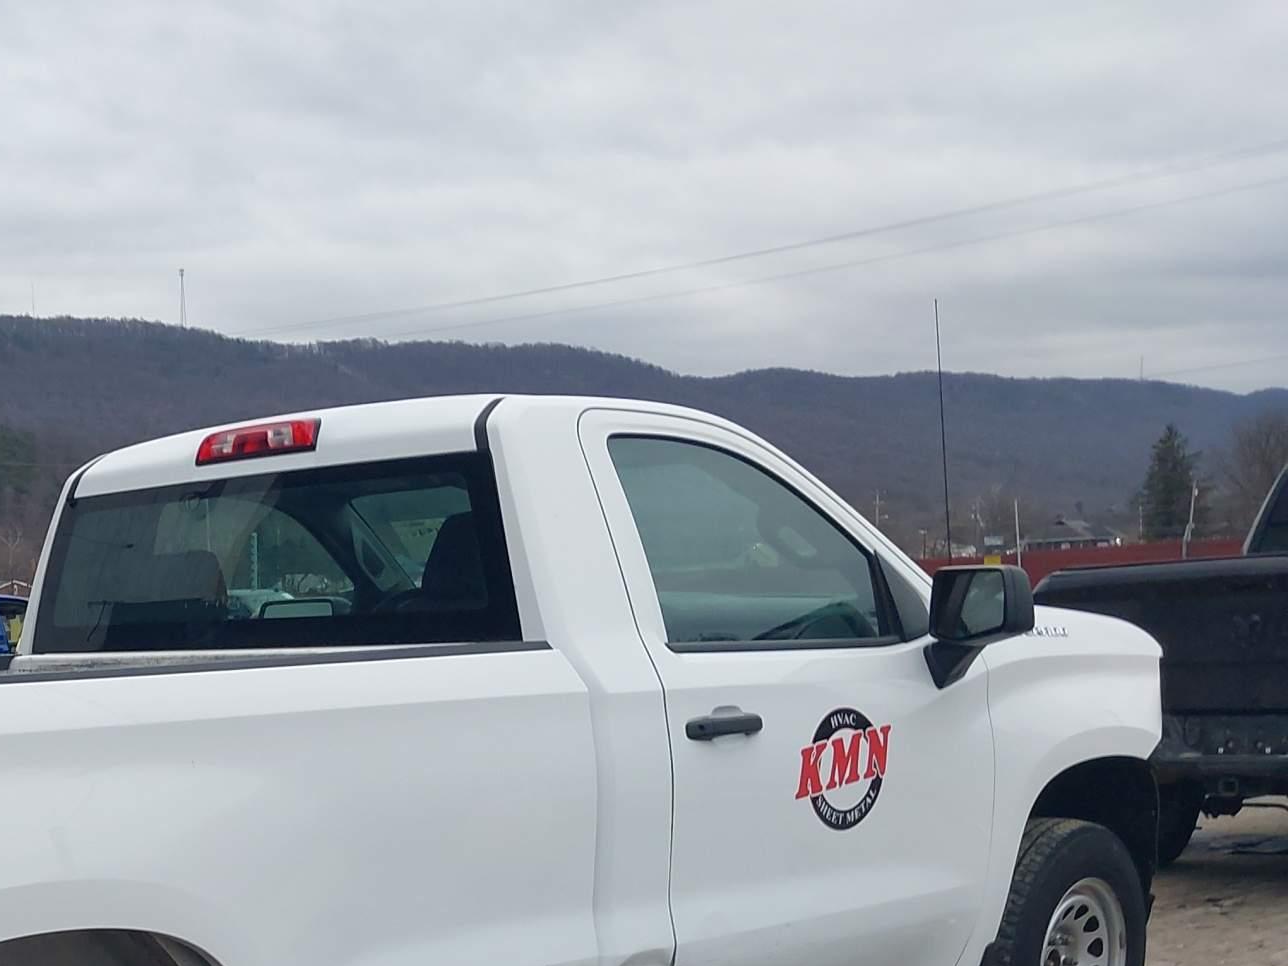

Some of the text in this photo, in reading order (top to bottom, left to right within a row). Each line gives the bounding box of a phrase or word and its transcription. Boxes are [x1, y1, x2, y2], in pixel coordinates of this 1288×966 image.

[830, 712, 857, 729] HVAC
[795, 725, 891, 800] KMN
[815, 788, 877, 825] SHEET METAL
